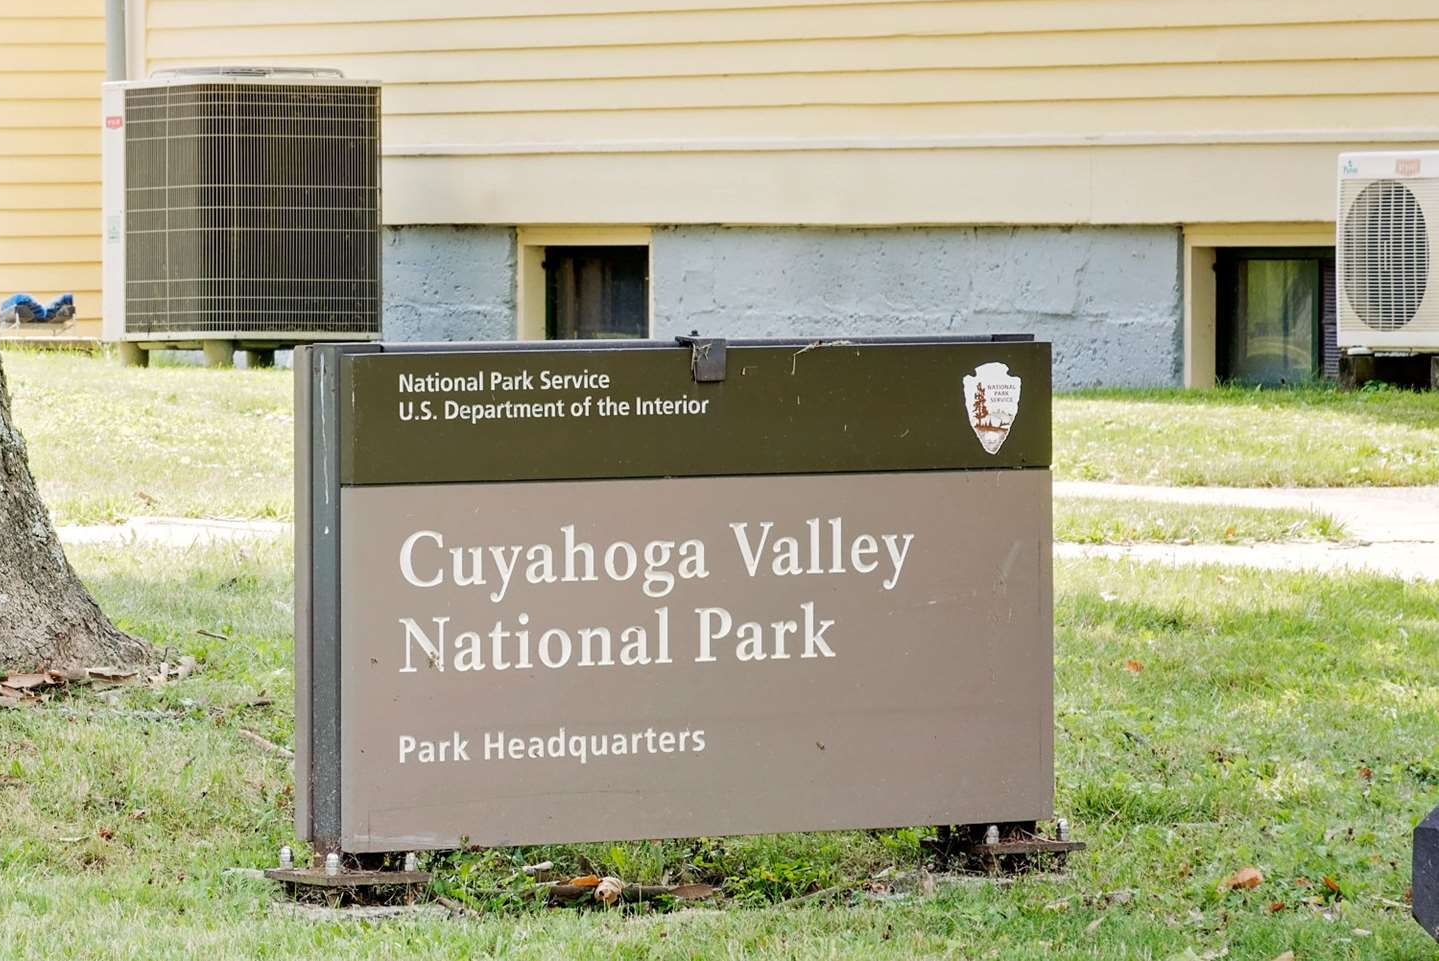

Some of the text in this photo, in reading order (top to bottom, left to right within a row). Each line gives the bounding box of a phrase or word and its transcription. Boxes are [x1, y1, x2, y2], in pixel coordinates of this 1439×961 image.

[398, 370, 611, 394] National Park Service
[398, 395, 710, 425] U.S. Department of the Interior
[398, 516, 915, 603] Cuyahoga Valley
[398, 601, 837, 673] National Park
[398, 726, 707, 764] Park Headquarters
